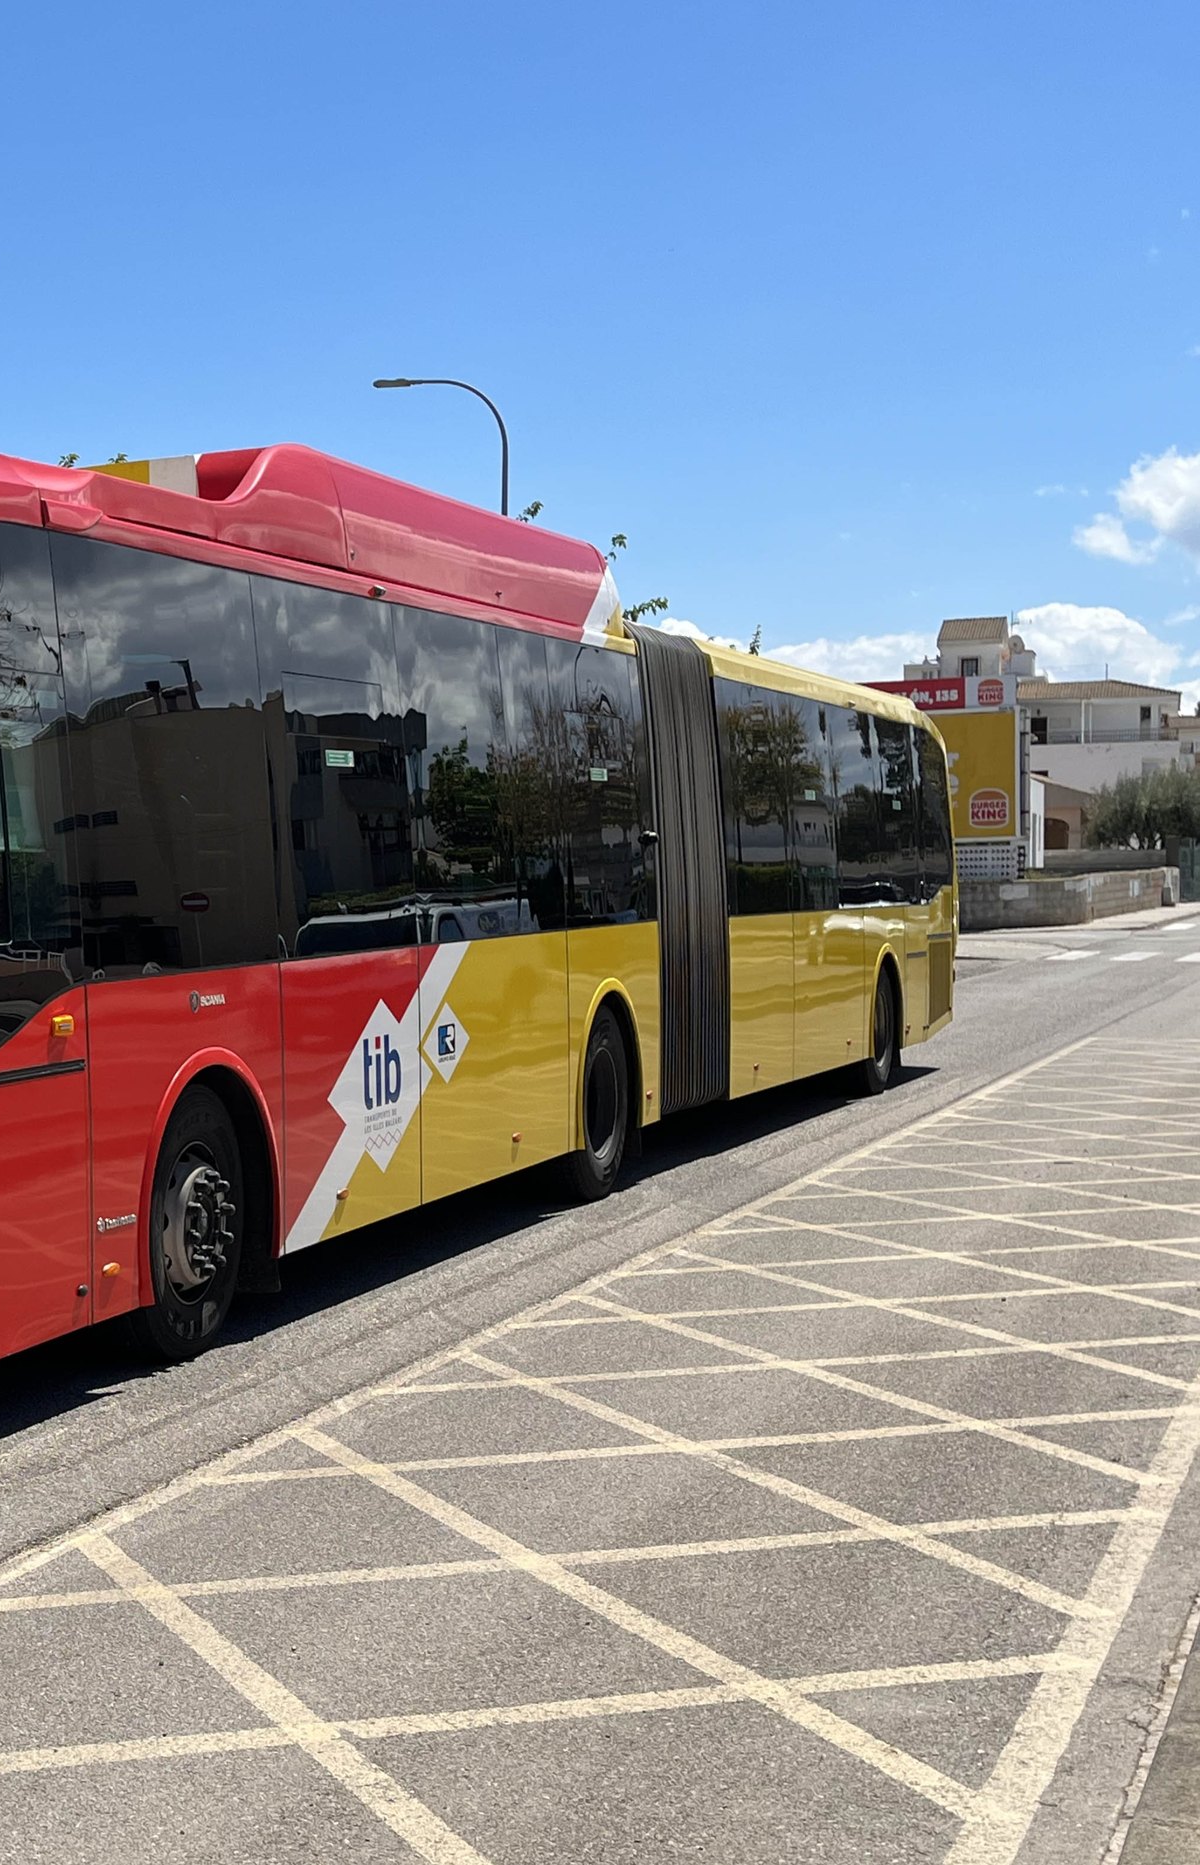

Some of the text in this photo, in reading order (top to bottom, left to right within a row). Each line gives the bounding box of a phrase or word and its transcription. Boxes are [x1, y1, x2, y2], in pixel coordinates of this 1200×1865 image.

[935, 690, 959, 702] 135
[978, 692, 1004, 703] KING
[971, 800, 1007, 809] BURGER
[971, 808, 1007, 820] KING
[363, 1034, 401, 1110] tib
